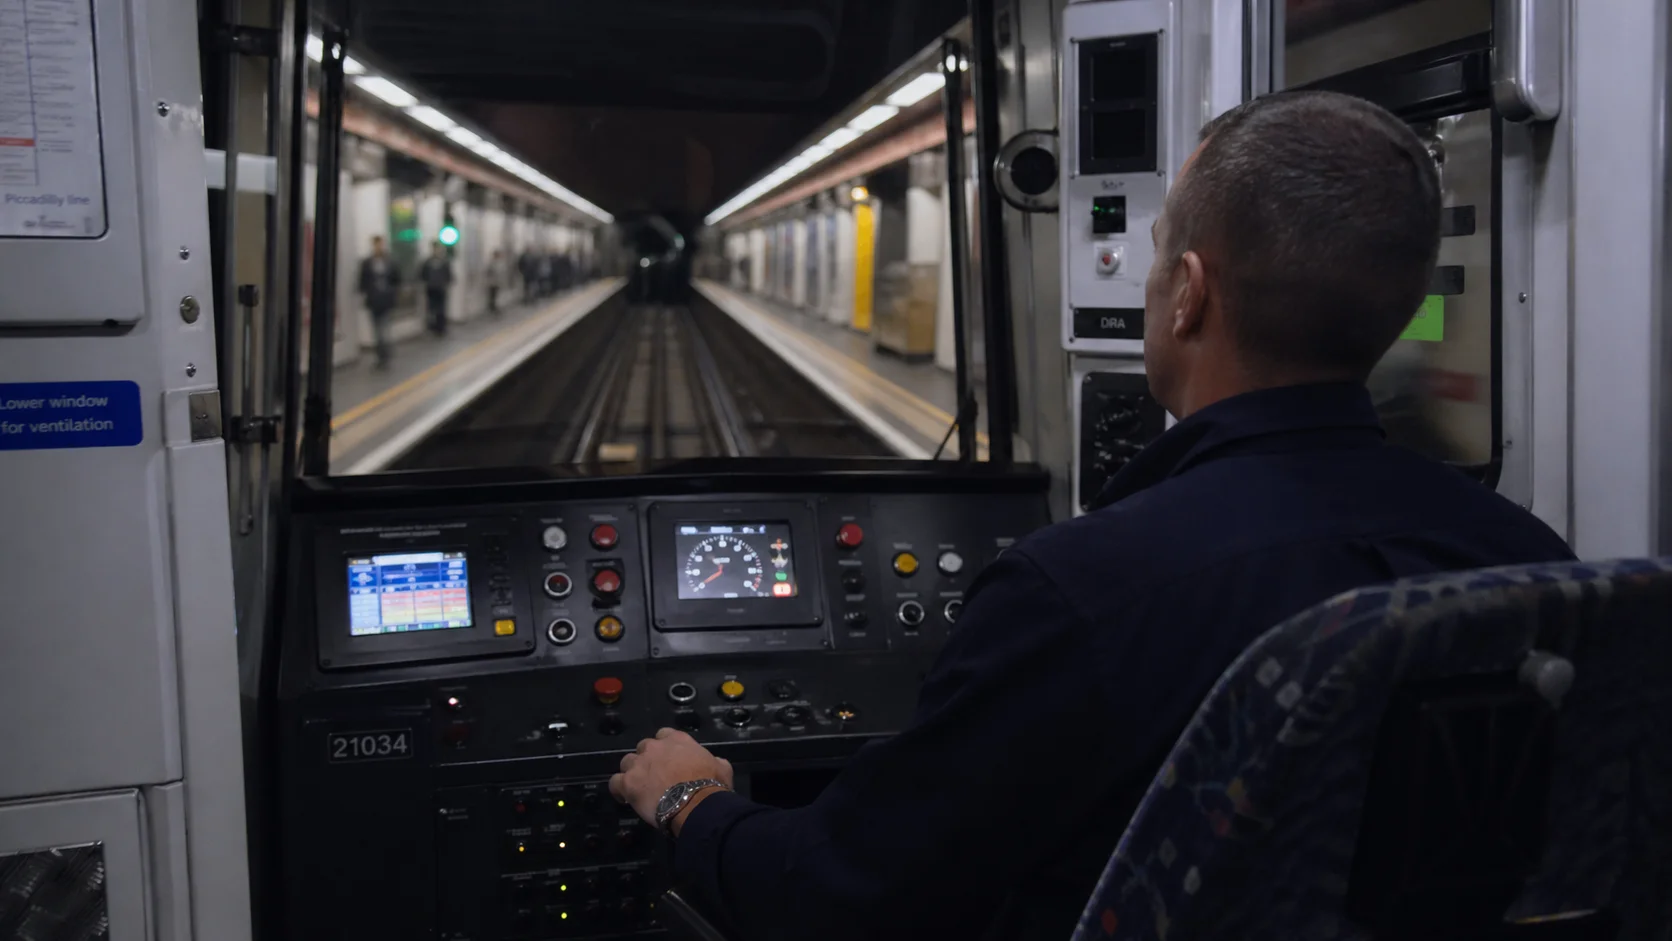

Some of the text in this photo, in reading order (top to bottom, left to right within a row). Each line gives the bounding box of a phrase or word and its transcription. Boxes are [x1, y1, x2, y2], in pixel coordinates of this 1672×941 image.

[5, 193, 91, 207] Piccadilly line
[1100, 316, 1126, 329] DRA
[0, 394, 109, 410] Lower window
[1, 417, 114, 434] for ventilation
[333, 733, 408, 758] 21034
